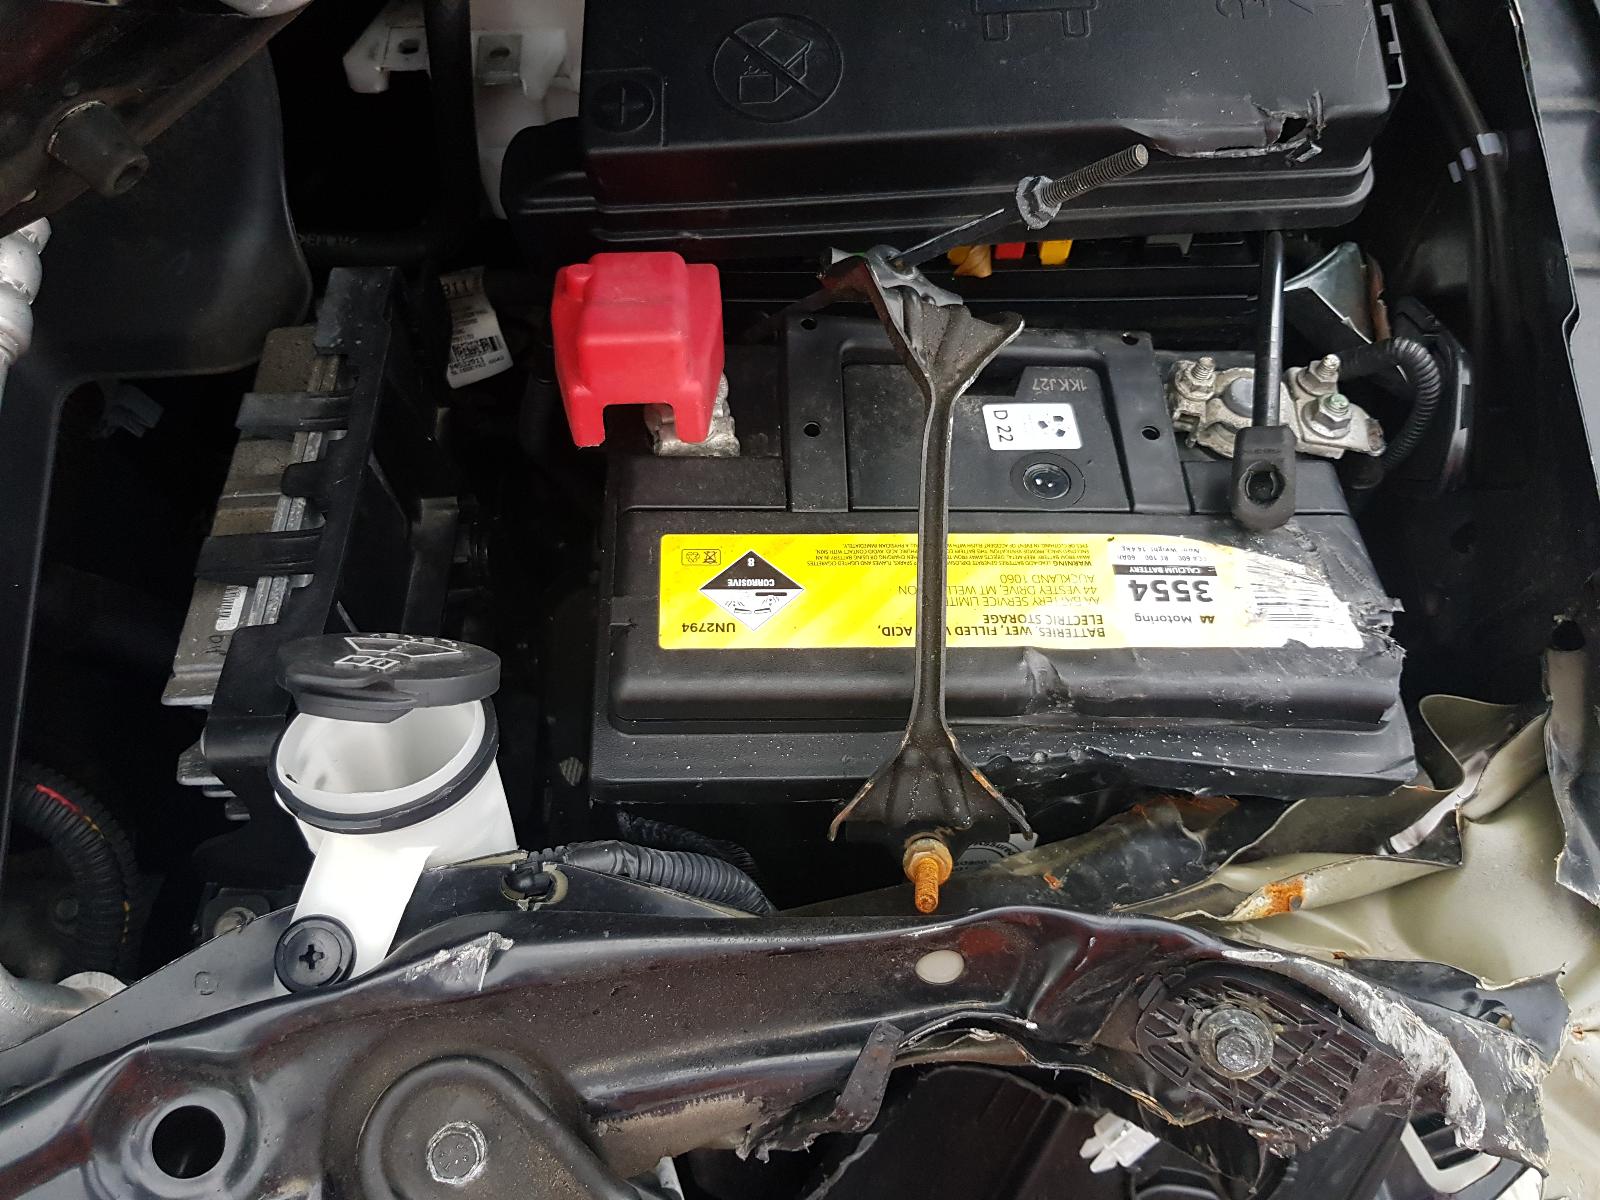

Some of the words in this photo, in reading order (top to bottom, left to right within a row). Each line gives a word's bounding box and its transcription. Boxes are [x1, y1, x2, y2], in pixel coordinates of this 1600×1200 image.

[747, 558, 755, 567] 8
[1129, 566, 1163, 574] BATTERY
[728, 578, 775, 587] CORROSIVE
[999, 574, 1027, 584] 1060
[1032, 574, 1095, 584] AUCKLAND
[980, 586, 996, 595] MT
[999, 584, 1035, 595] DRIVE,
[1040, 586, 1081, 595] VESTEY
[1083, 586, 1097, 595] 44
[1128, 580, 1213, 602] 3554
[982, 596, 1029, 607] SERVICE
[982, 614, 1041, 625] STORAGE
[1044, 614, 1104, 626] ELECTRIC
[1135, 613, 1192, 624] Motoring
[1200, 616, 1215, 624] AA
[681, 622, 735, 633] UN2794
[878, 625, 913, 636] ACID,
[955, 626, 997, 636] FILLED
[1001, 625, 1032, 636] WET,
[1035, 626, 1105, 638] BATTERIES,
